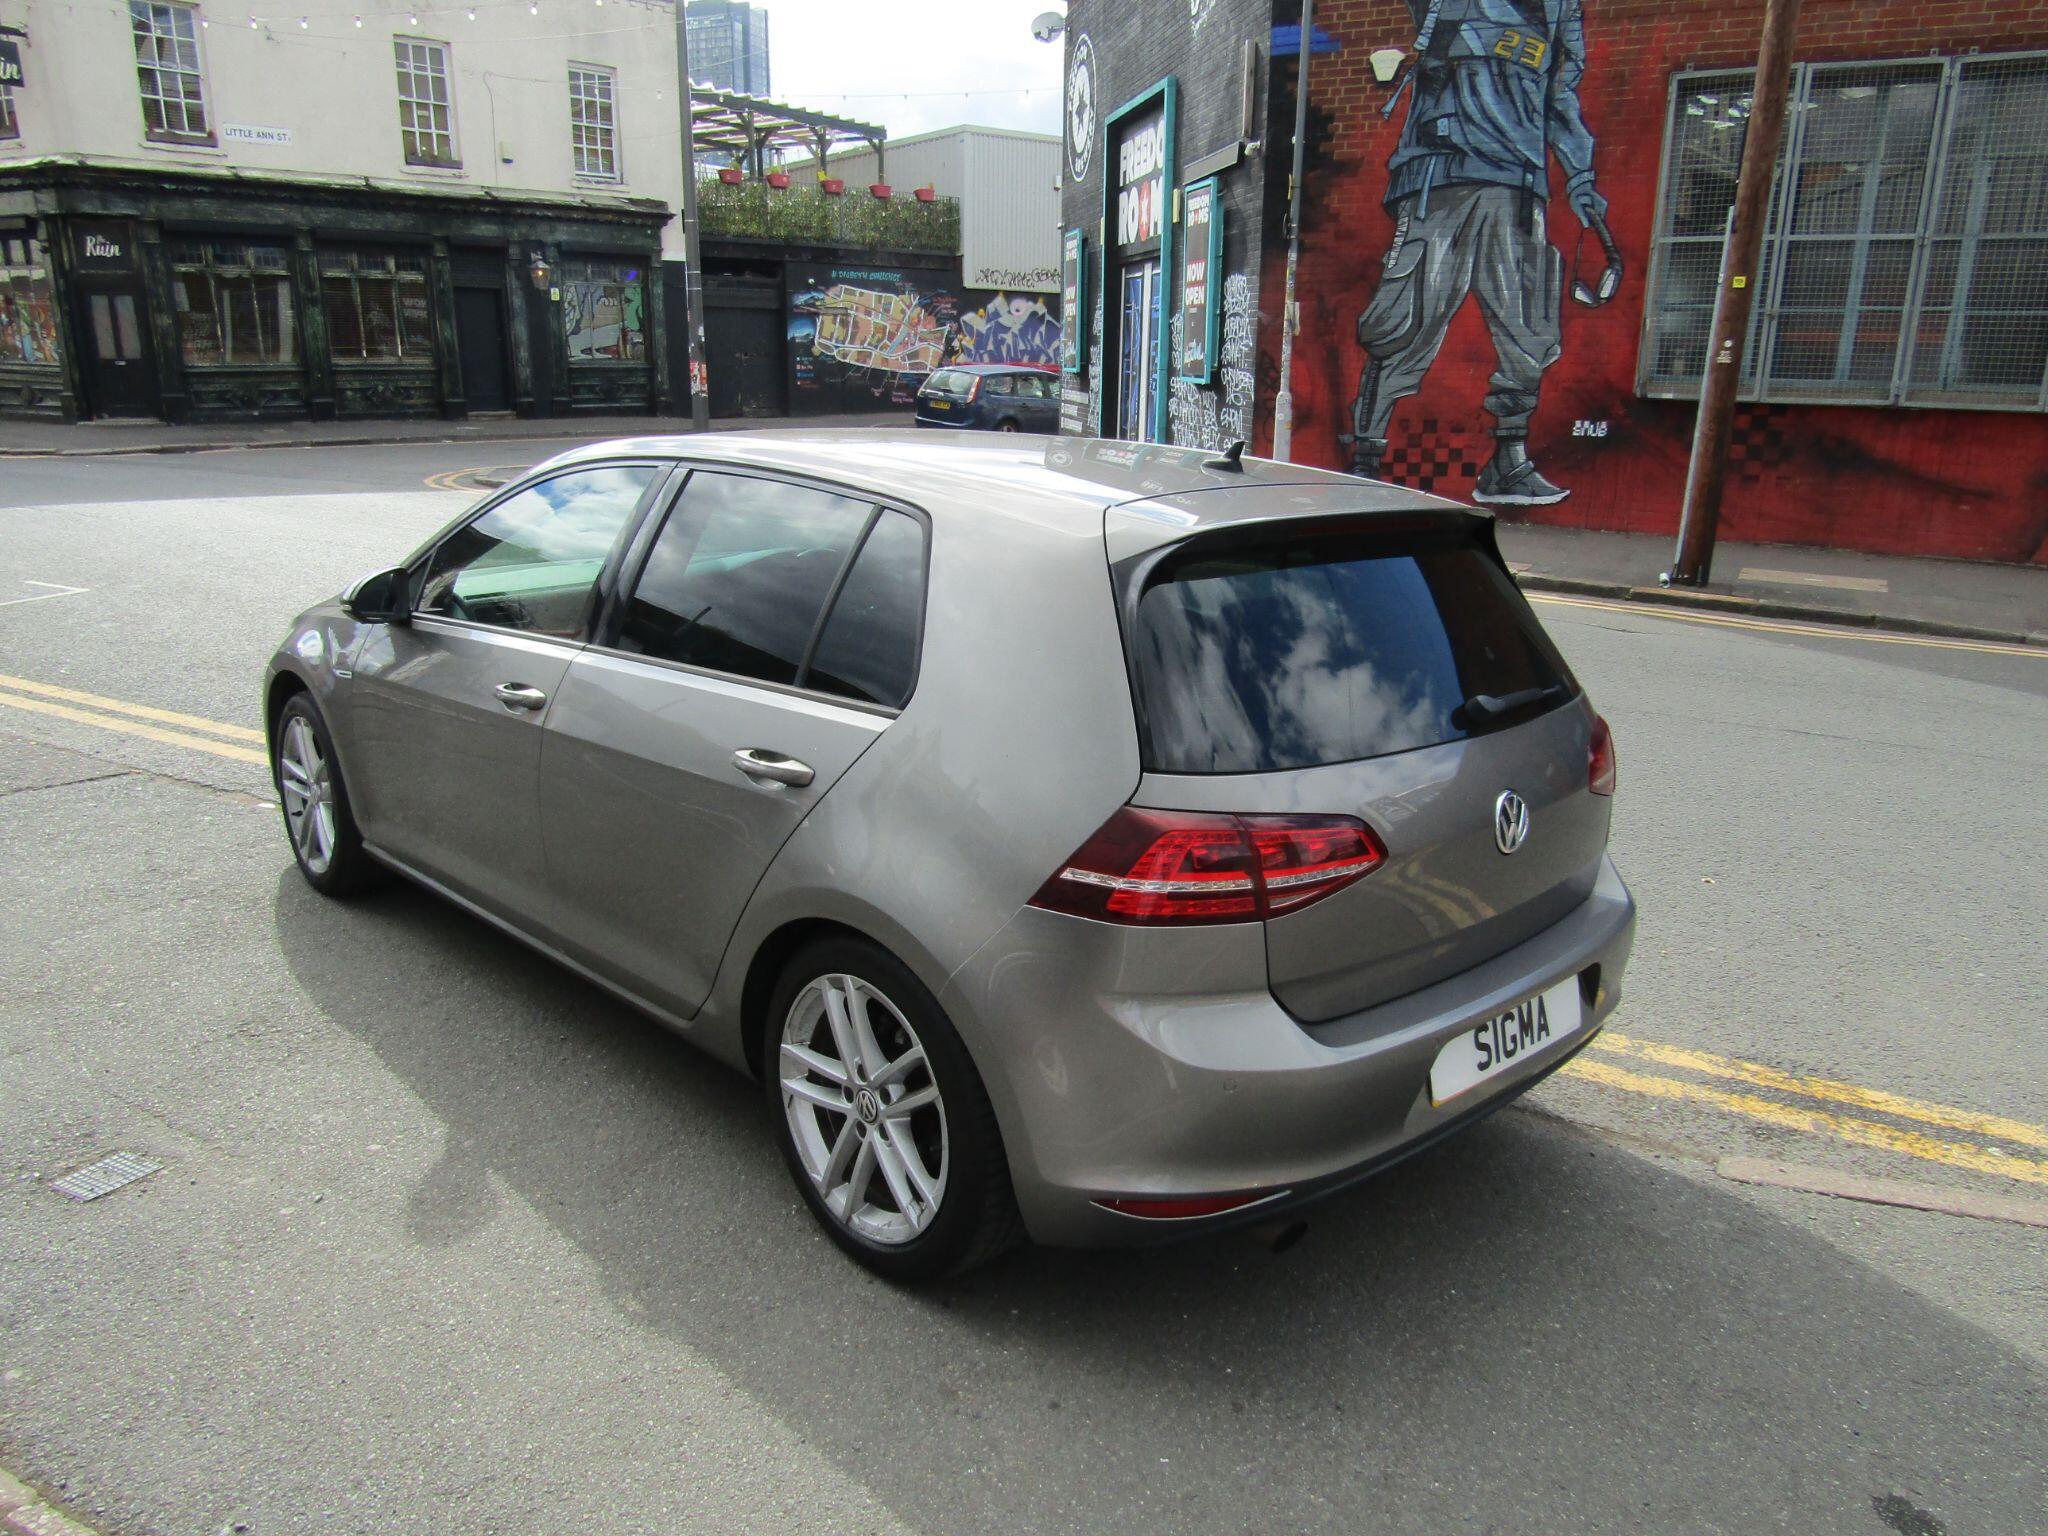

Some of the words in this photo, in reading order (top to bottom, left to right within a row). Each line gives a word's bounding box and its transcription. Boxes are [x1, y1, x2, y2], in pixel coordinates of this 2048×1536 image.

[1494, 30, 1546, 68] 23
[225, 127, 254, 139] LITTLE
[256, 131, 275, 140] ANN
[1119, 116, 1165, 188] FREEDO
[86, 235, 122, 258] Ruin
[1186, 261, 1205, 283] NOW
[1185, 285, 1205, 306] OPEN
[1474, 994, 1551, 1072] SIGMA
